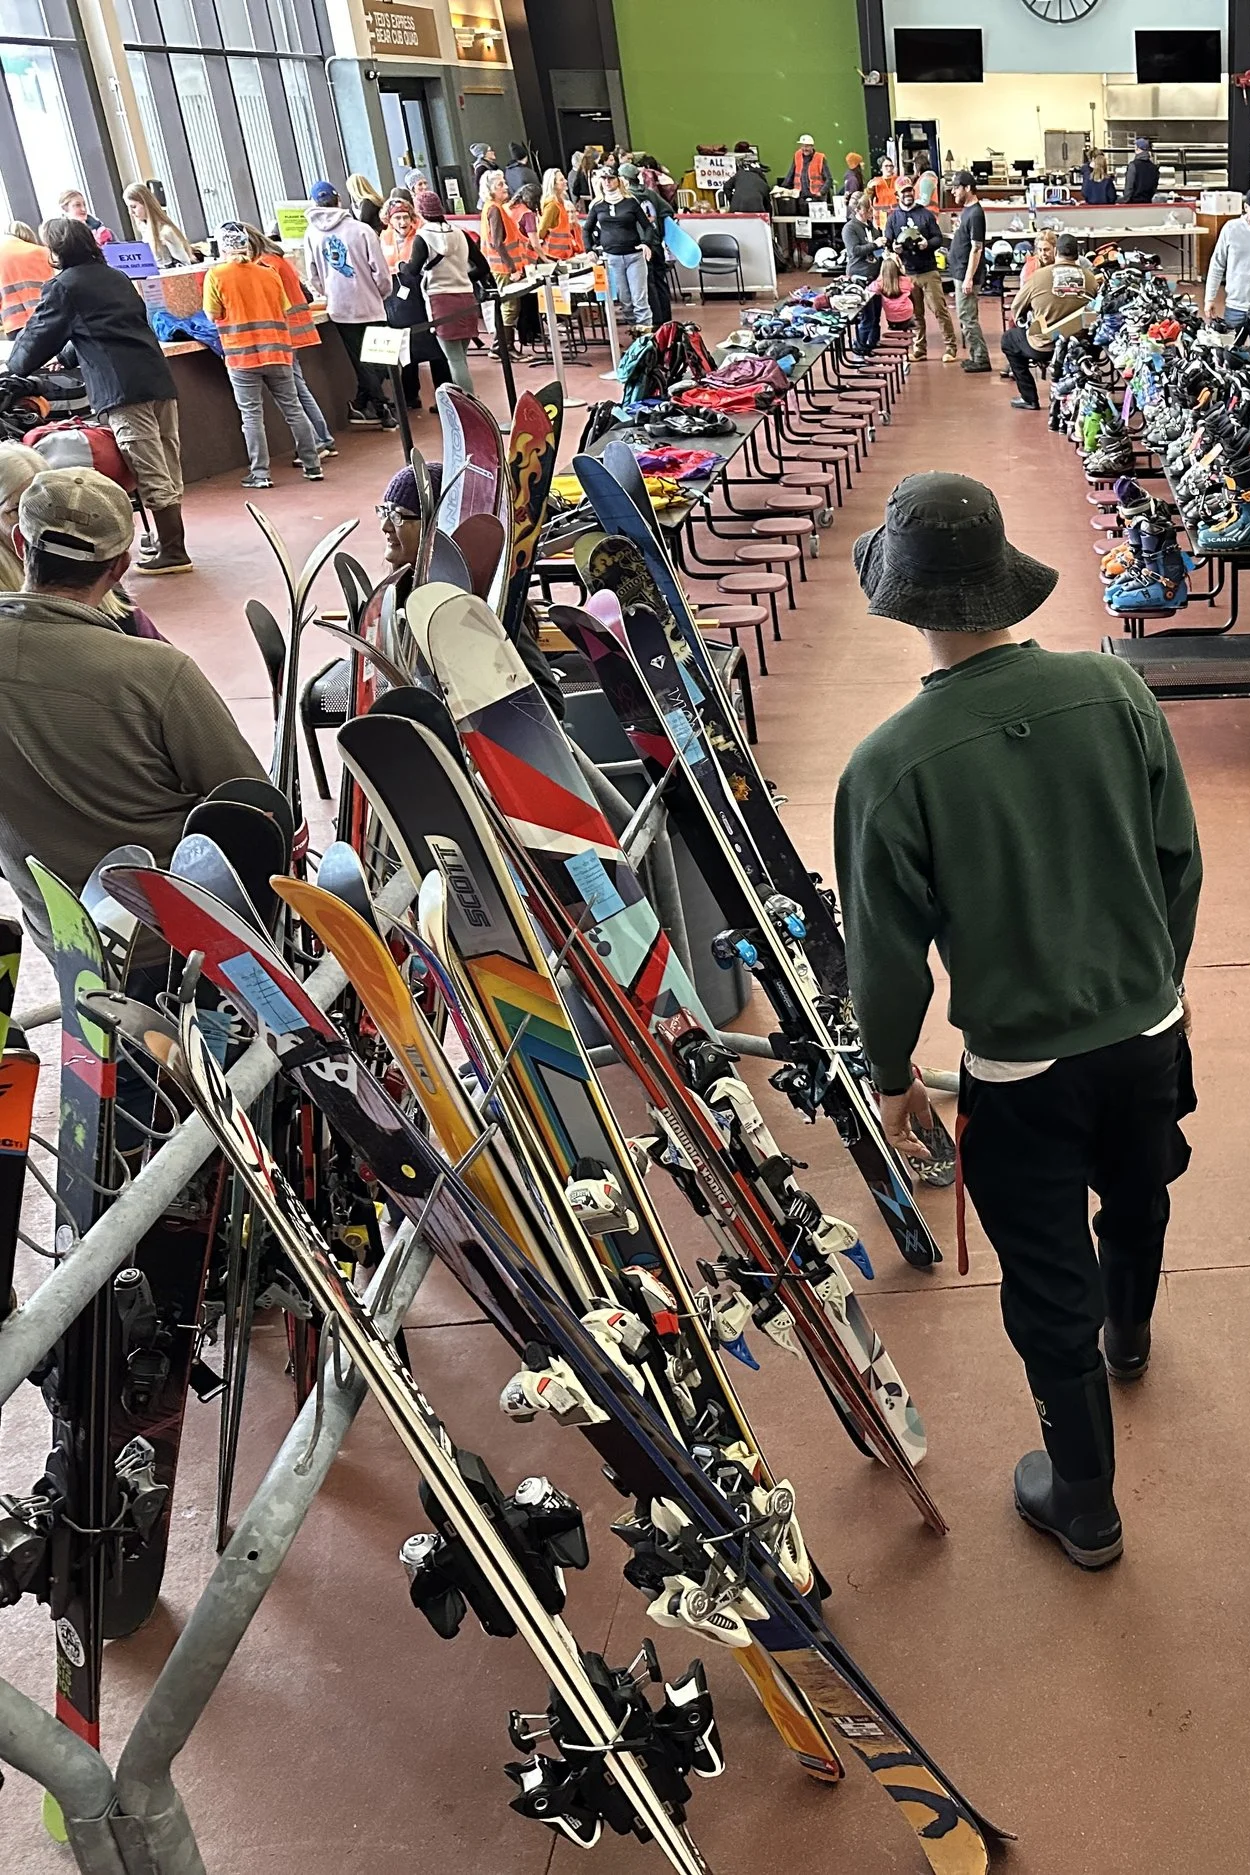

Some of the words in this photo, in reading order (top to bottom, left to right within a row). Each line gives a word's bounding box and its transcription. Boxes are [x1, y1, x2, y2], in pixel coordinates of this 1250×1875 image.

[390, 13, 416, 30] EXPRESS
[375, 28, 392, 43] BEAR
[391, 29, 404, 44] CUB
[709, 157, 725, 168] ALL
[119, 253, 142, 262] EXIT
[432, 843, 491, 927] SCOTT
